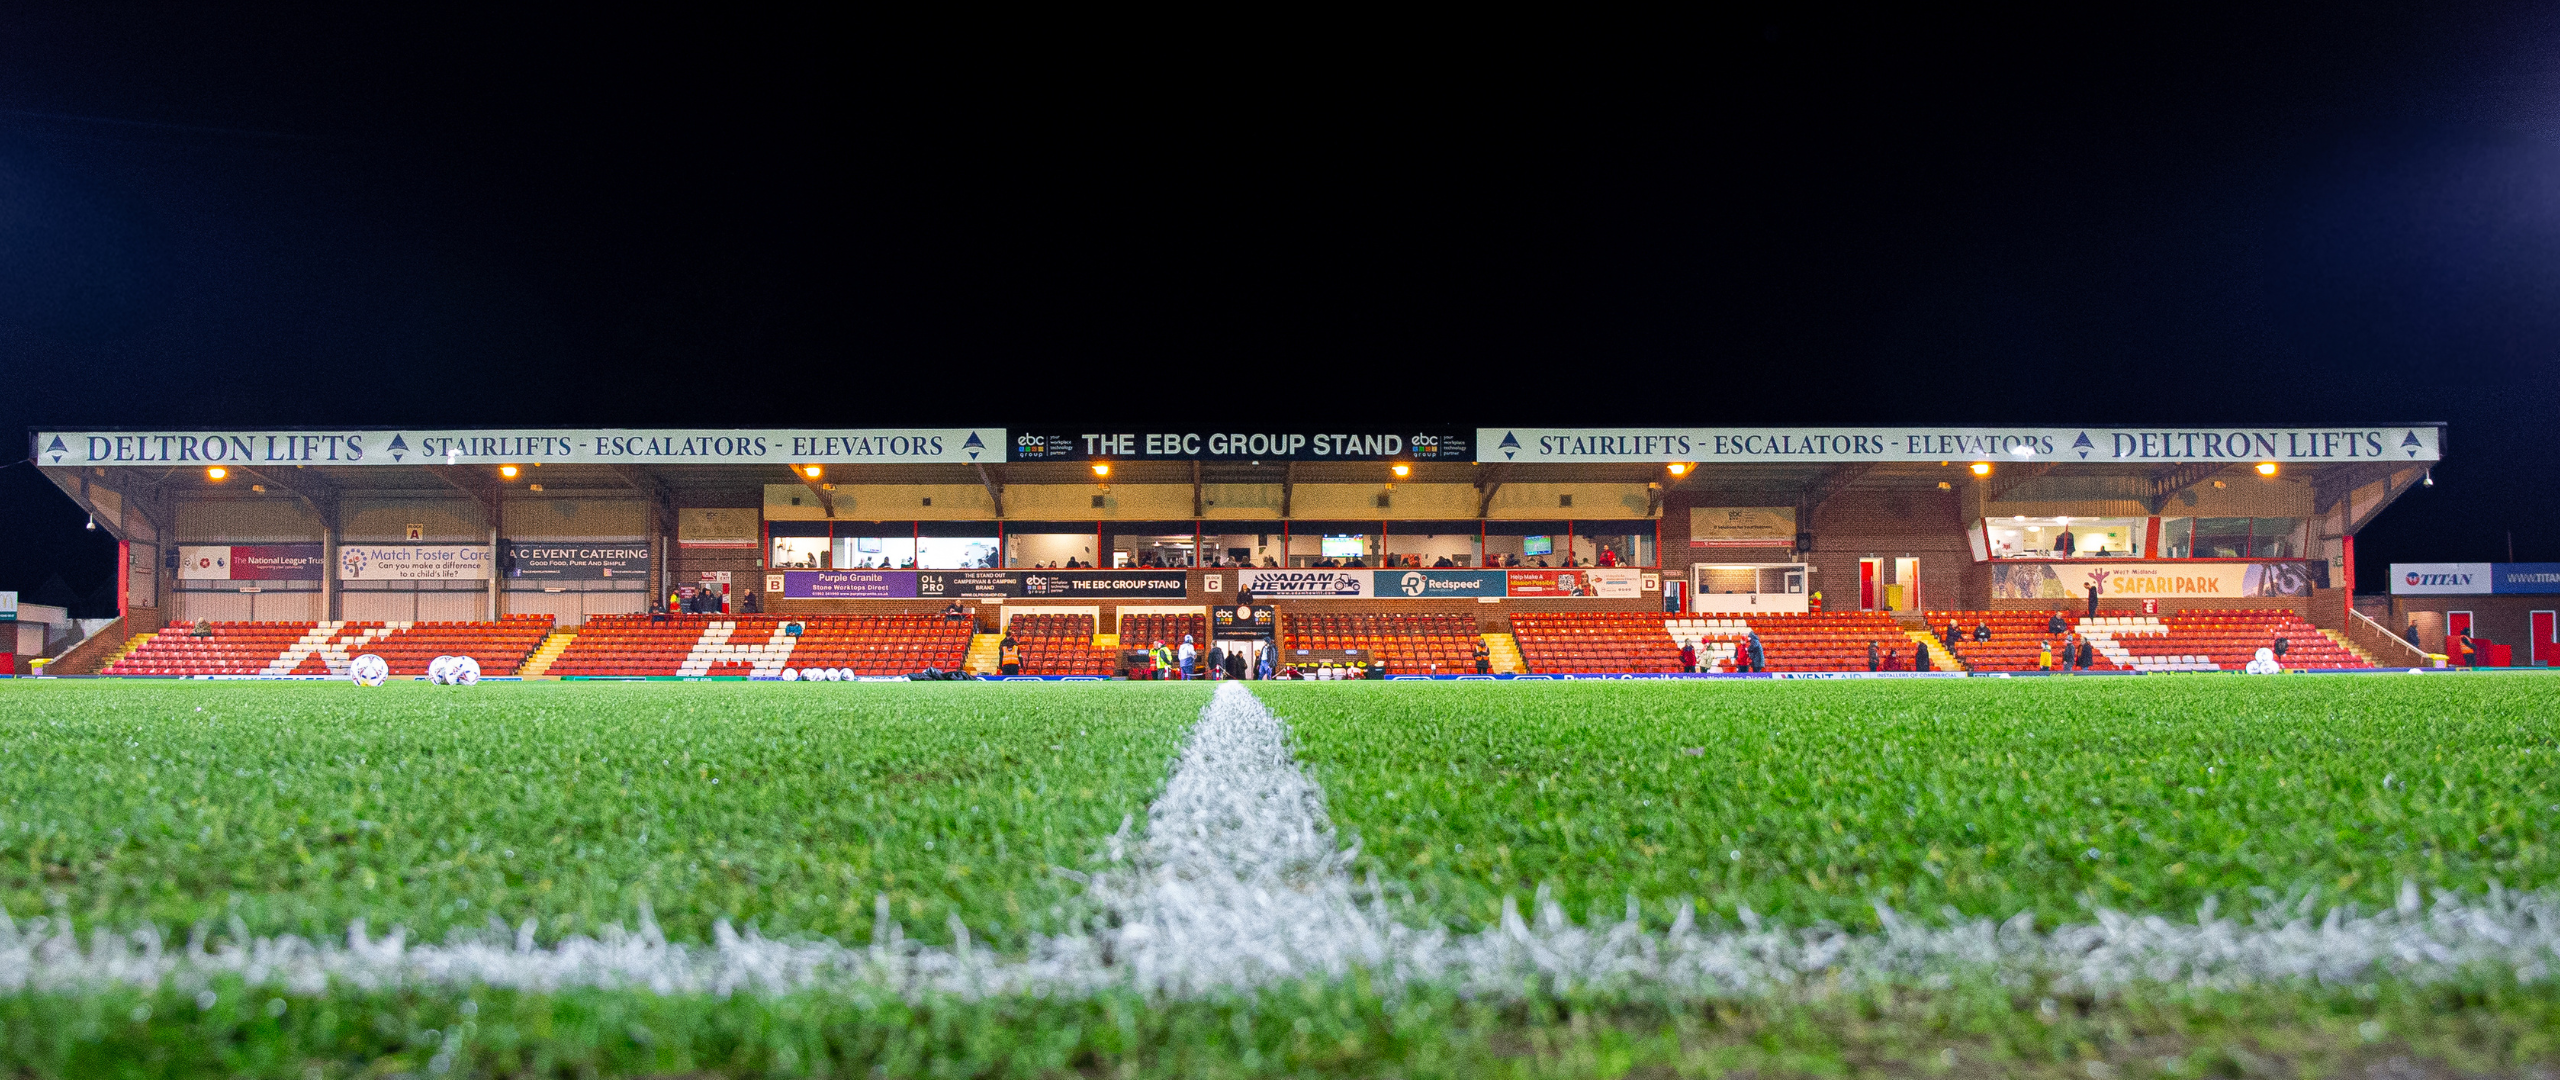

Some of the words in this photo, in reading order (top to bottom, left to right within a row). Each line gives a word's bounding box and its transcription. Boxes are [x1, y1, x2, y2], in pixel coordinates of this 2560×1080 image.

[1017, 433, 1045, 446] ebc
[1081, 433, 1136, 455] THE
[1146, 433, 1201, 455] EBC
[1208, 433, 1306, 455] GROUP
[1312, 433, 1403, 455] STAND
[1411, 433, 1438, 446] ebc
[1539, 435, 1690, 455] STAIRLIFTS
[1713, 435, 1884, 455] ESCALATORS
[1906, 434, 2054, 455] ELEVATORS
[86, 436, 255, 462] DELTRON
[264, 435, 364, 462] LIFTS
[421, 436, 572, 457] STAIRLIFTS
[595, 436, 768, 457] ESCALATORS
[791, 436, 943, 456] ELEVATORS
[2111, 432, 2282, 458] DELTRON
[2286, 432, 2383, 457] LIFTS
[410, 529, 420, 540] A
[370, 548, 411, 561] Match
[415, 548, 457, 561] Foster
[460, 548, 491, 561] Care
[520, 550, 530, 558] C
[533, 550, 577, 558] EVENT
[580, 550, 648, 558] CATERING
[234, 556, 247, 565] The
[248, 556, 280, 565] National
[281, 556, 307, 567] League
[308, 556, 324, 565] Trus
[378, 562, 392, 570] Can
[442, 561, 481, 569] difference
[819, 574, 848, 583] Purple
[850, 573, 882, 582] Granite
[921, 575, 936, 583] OL
[1026, 575, 1047, 585] ebc
[1274, 573, 1334, 581] ADAM
[2420, 573, 2473, 586] TITAN
[771, 581, 780, 590] B
[833, 584, 866, 592] Worktops
[922, 584, 944, 592] PRO
[1072, 580, 1092, 588] THE
[1093, 580, 1111, 589] EBC
[1112, 580, 1147, 589] GROUP
[1148, 580, 1180, 588] STAND
[1209, 581, 1218, 589] C
[1251, 582, 1332, 591] HEWITT
[1429, 579, 1480, 591] Redspeed
[1645, 580, 1655, 589] D
[2113, 577, 2173, 594] SAFARI
[2176, 576, 2219, 593] PARK
[1215, 608, 1233, 618] ebc
[1254, 608, 1272, 618] ebc
[2146, 604, 2154, 613] E
